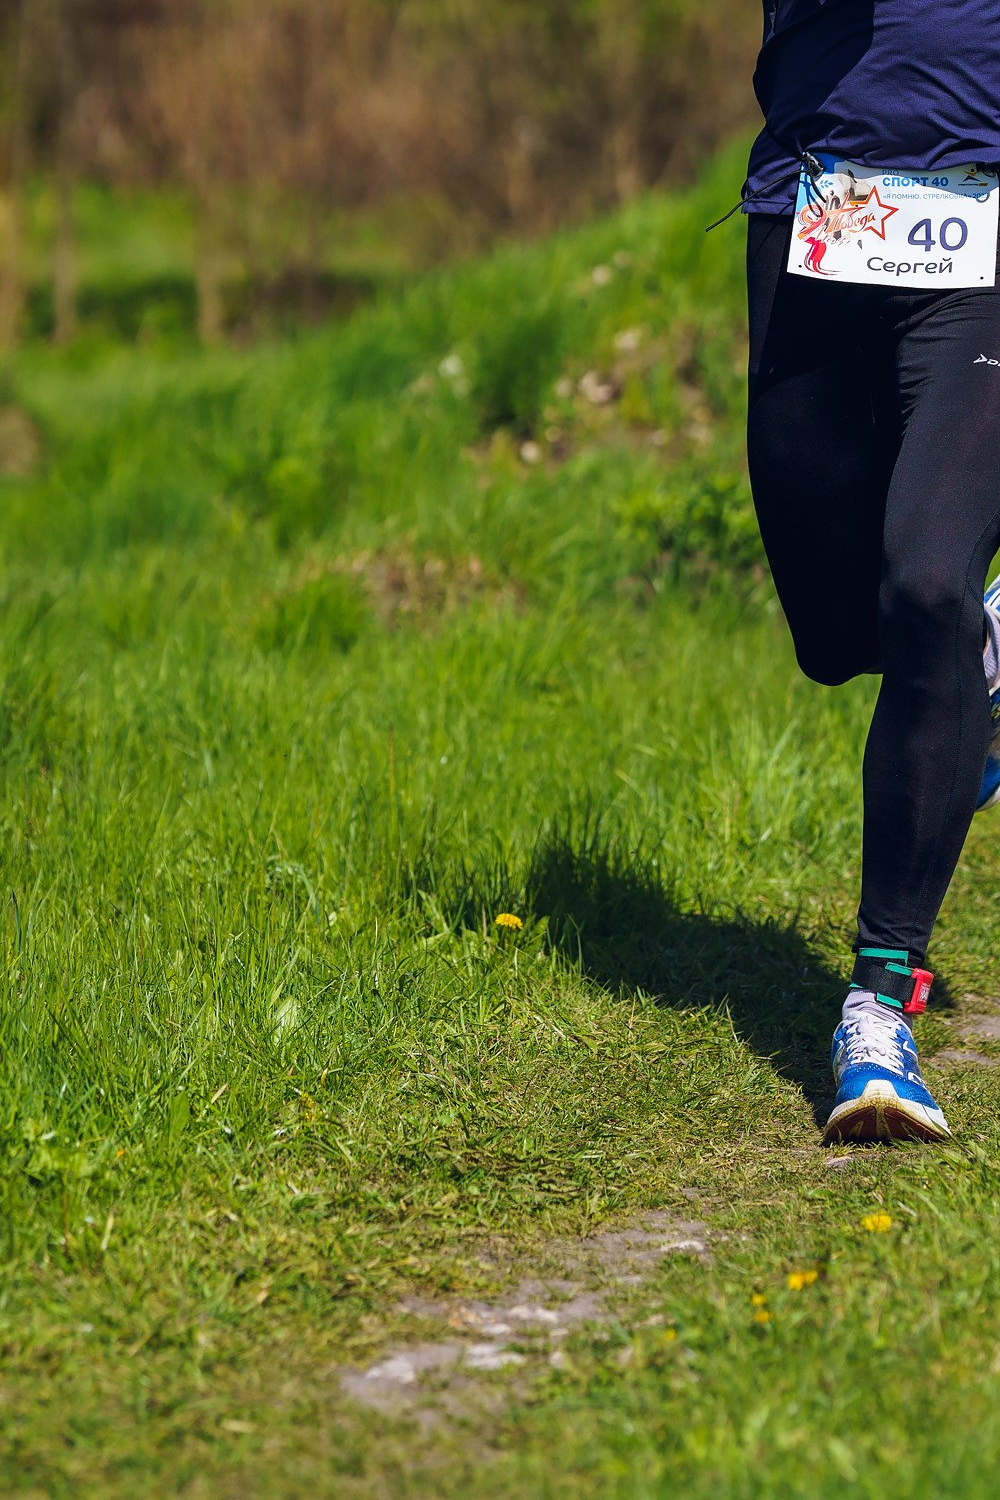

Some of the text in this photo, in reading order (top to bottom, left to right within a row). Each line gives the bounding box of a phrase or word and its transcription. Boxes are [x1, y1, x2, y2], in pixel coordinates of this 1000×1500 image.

[882, 176, 929, 187] СПОРТ
[931, 177, 949, 187] 40
[907, 217, 968, 252] 40
[866, 257, 953, 276] Сергей
